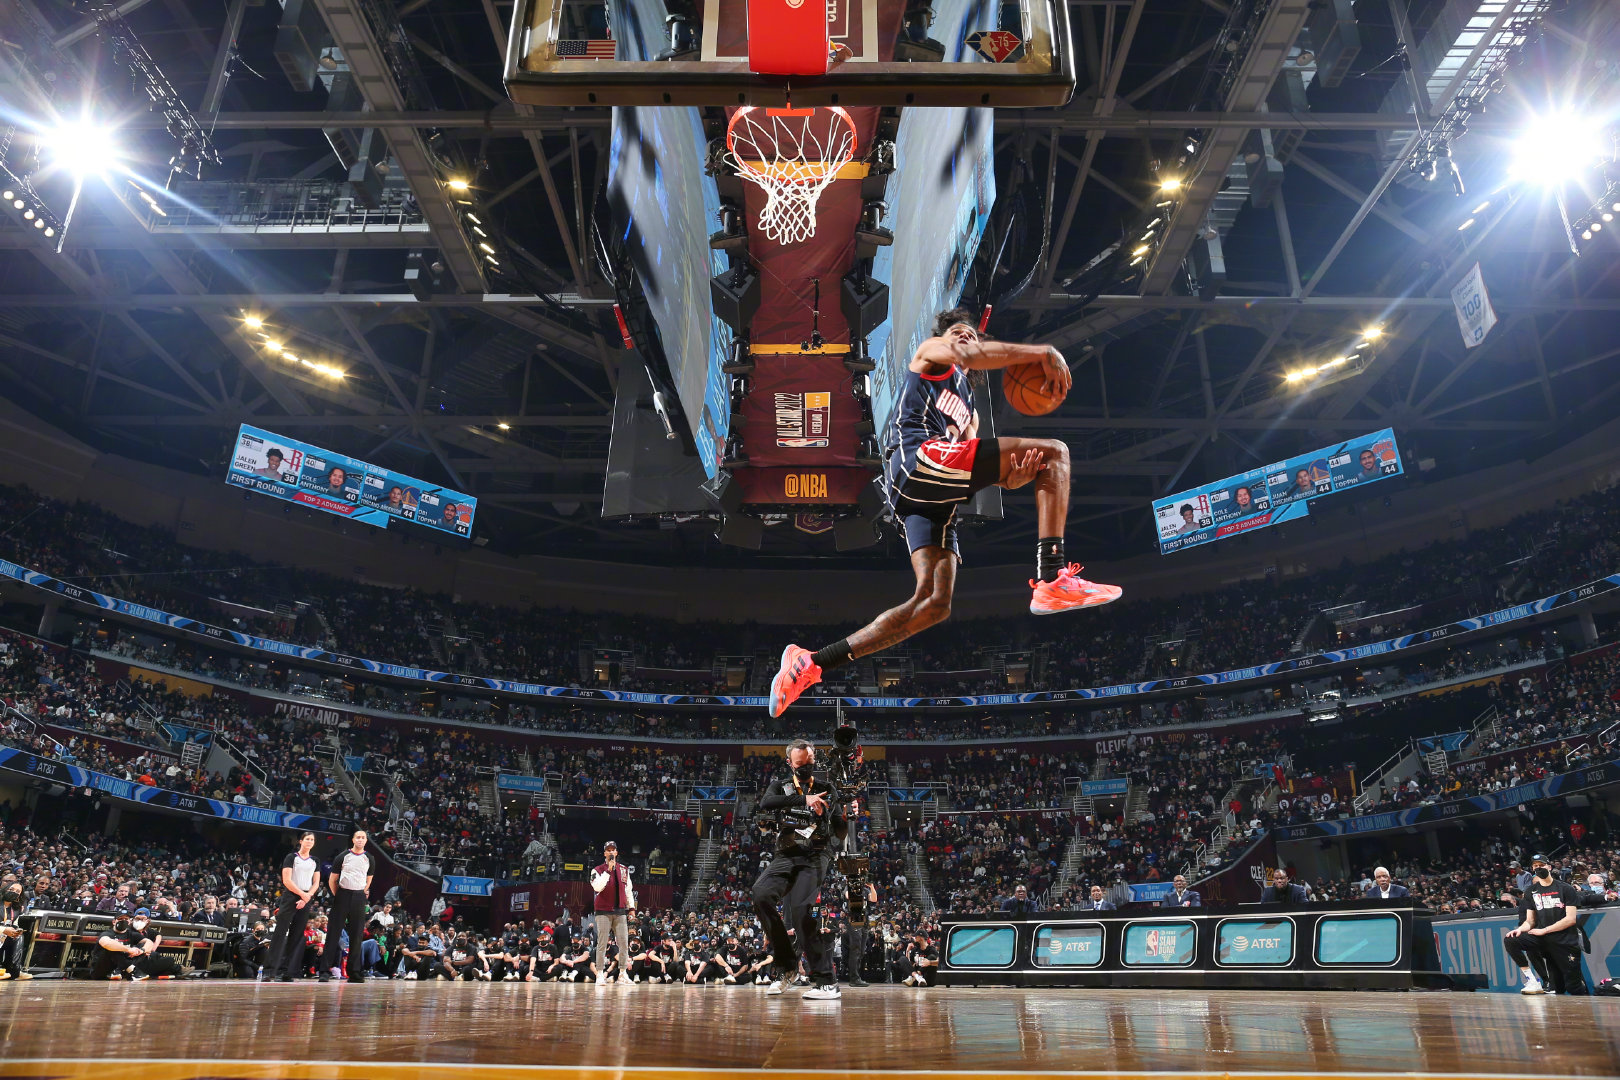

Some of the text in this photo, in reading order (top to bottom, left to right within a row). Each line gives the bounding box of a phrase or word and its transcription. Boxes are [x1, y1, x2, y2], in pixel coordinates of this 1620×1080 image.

[998, 36, 1009, 47] 75
[1462, 293, 1481, 320] 100
[241, 438, 251, 447] 38
[236, 455, 257, 465] JALEN
[234, 461, 256, 472] GREEN
[1384, 464, 1396, 474] 44
[283, 474, 295, 484] 38
[301, 474, 318, 483] COLE
[365, 477, 374, 485] 44
[1335, 477, 1359, 489] TOPPIN
[231, 473, 286, 495] FIRST ROUND
[299, 480, 329, 494] ANTHONY
[784, 473, 828, 498] @NBA
[1319, 484, 1330, 493] 44
[345, 492, 356, 501] 40
[303, 494, 316, 503] TOP
[320, 499, 350, 513] ADVANCE
[1258, 501, 1268, 510] 40
[403, 509, 413, 518] 44
[1213, 507, 1228, 516] COLE
[1201, 518, 1211, 526] 38
[1215, 511, 1242, 523] ANTHONY
[1161, 523, 1177, 532] JALEN
[1223, 525, 1235, 533] TOP
[1240, 516, 1267, 529] ADVANCE
[457, 526, 466, 534] 44
[1163, 532, 1208, 550] FIRST ROUND
[0, 561, 17, 577] DUNK
[64, 587, 82, 598] AT&T
[1578, 585, 1596, 598] AT&T
[129, 604, 162, 622] SLAM DUNK
[1494, 605, 1528, 623] SLAM DUNK
[206, 628, 223, 637] AT&T
[1432, 628, 1448, 638] AT&T
[263, 641, 294, 655] SLAM DUNK
[1357, 643, 1388, 657] SLAM DUNK
[337, 657, 353, 665] AT&T
[1298, 658, 1314, 667] AT&T
[460, 677, 475, 685] AT&T
[1173, 679, 1188, 687] AT&T
[36, 763, 57, 775] AT&T
[1587, 770, 1605, 782] AT&T
[99, 776, 130, 797] SLAM DUNK
[179, 798, 198, 808] AT&T
[1443, 804, 1461, 815] AT&T
[242, 806, 278, 824] SLAM DUNK
[329, 822, 347, 832] AT&T
[1357, 814, 1393, 831] SLAM DUNK
[1290, 828, 1307, 837] AT&T
[1250, 866, 1275, 881] CLE 22
[47, 919, 57, 927] NBA
[1159, 936, 1176, 946] SLAM
[1250, 938, 1281, 949] AT&T
[1065, 942, 1092, 952] AT&T
[1159, 945, 1176, 955] DUNK
[1445, 927, 1499, 987] SLAM
